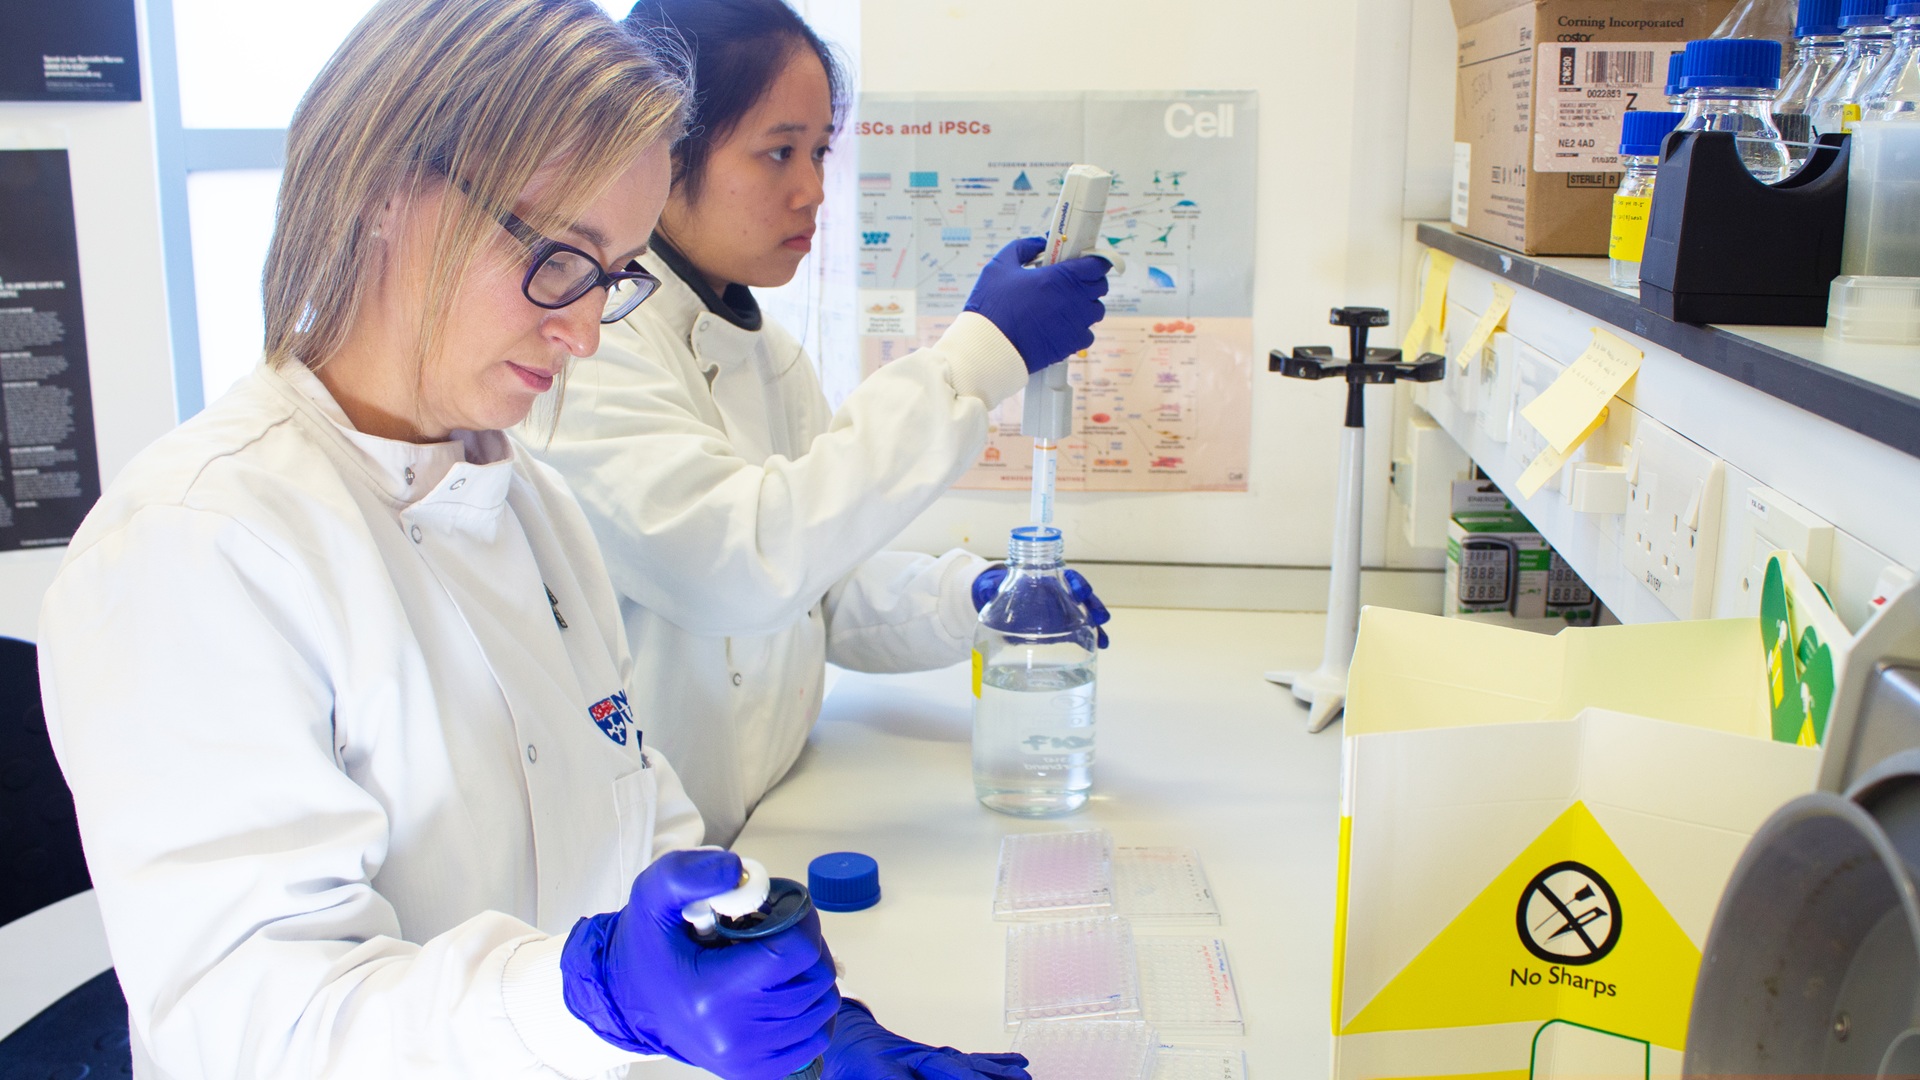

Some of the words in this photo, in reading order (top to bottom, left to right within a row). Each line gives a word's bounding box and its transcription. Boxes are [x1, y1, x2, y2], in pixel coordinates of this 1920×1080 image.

[1557, 15, 1606, 30] Corning
[1609, 16, 1685, 31] Incorporated
[1625, 93, 1638, 111] Z
[900, 121, 932, 136] and
[938, 120, 992, 136] iPSCs
[1164, 102, 1235, 139] Cell
[1577, 138, 1596, 148] 4AD
[1570, 174, 1603, 184] STERILE
[1608, 175, 1616, 184] R
[1057, 201, 1070, 235] eppendorf
[1299, 367, 1306, 377] 6
[1377, 371, 1385, 382] 7
[1510, 967, 1542, 987] No
[1548, 965, 1617, 998] Sharps
